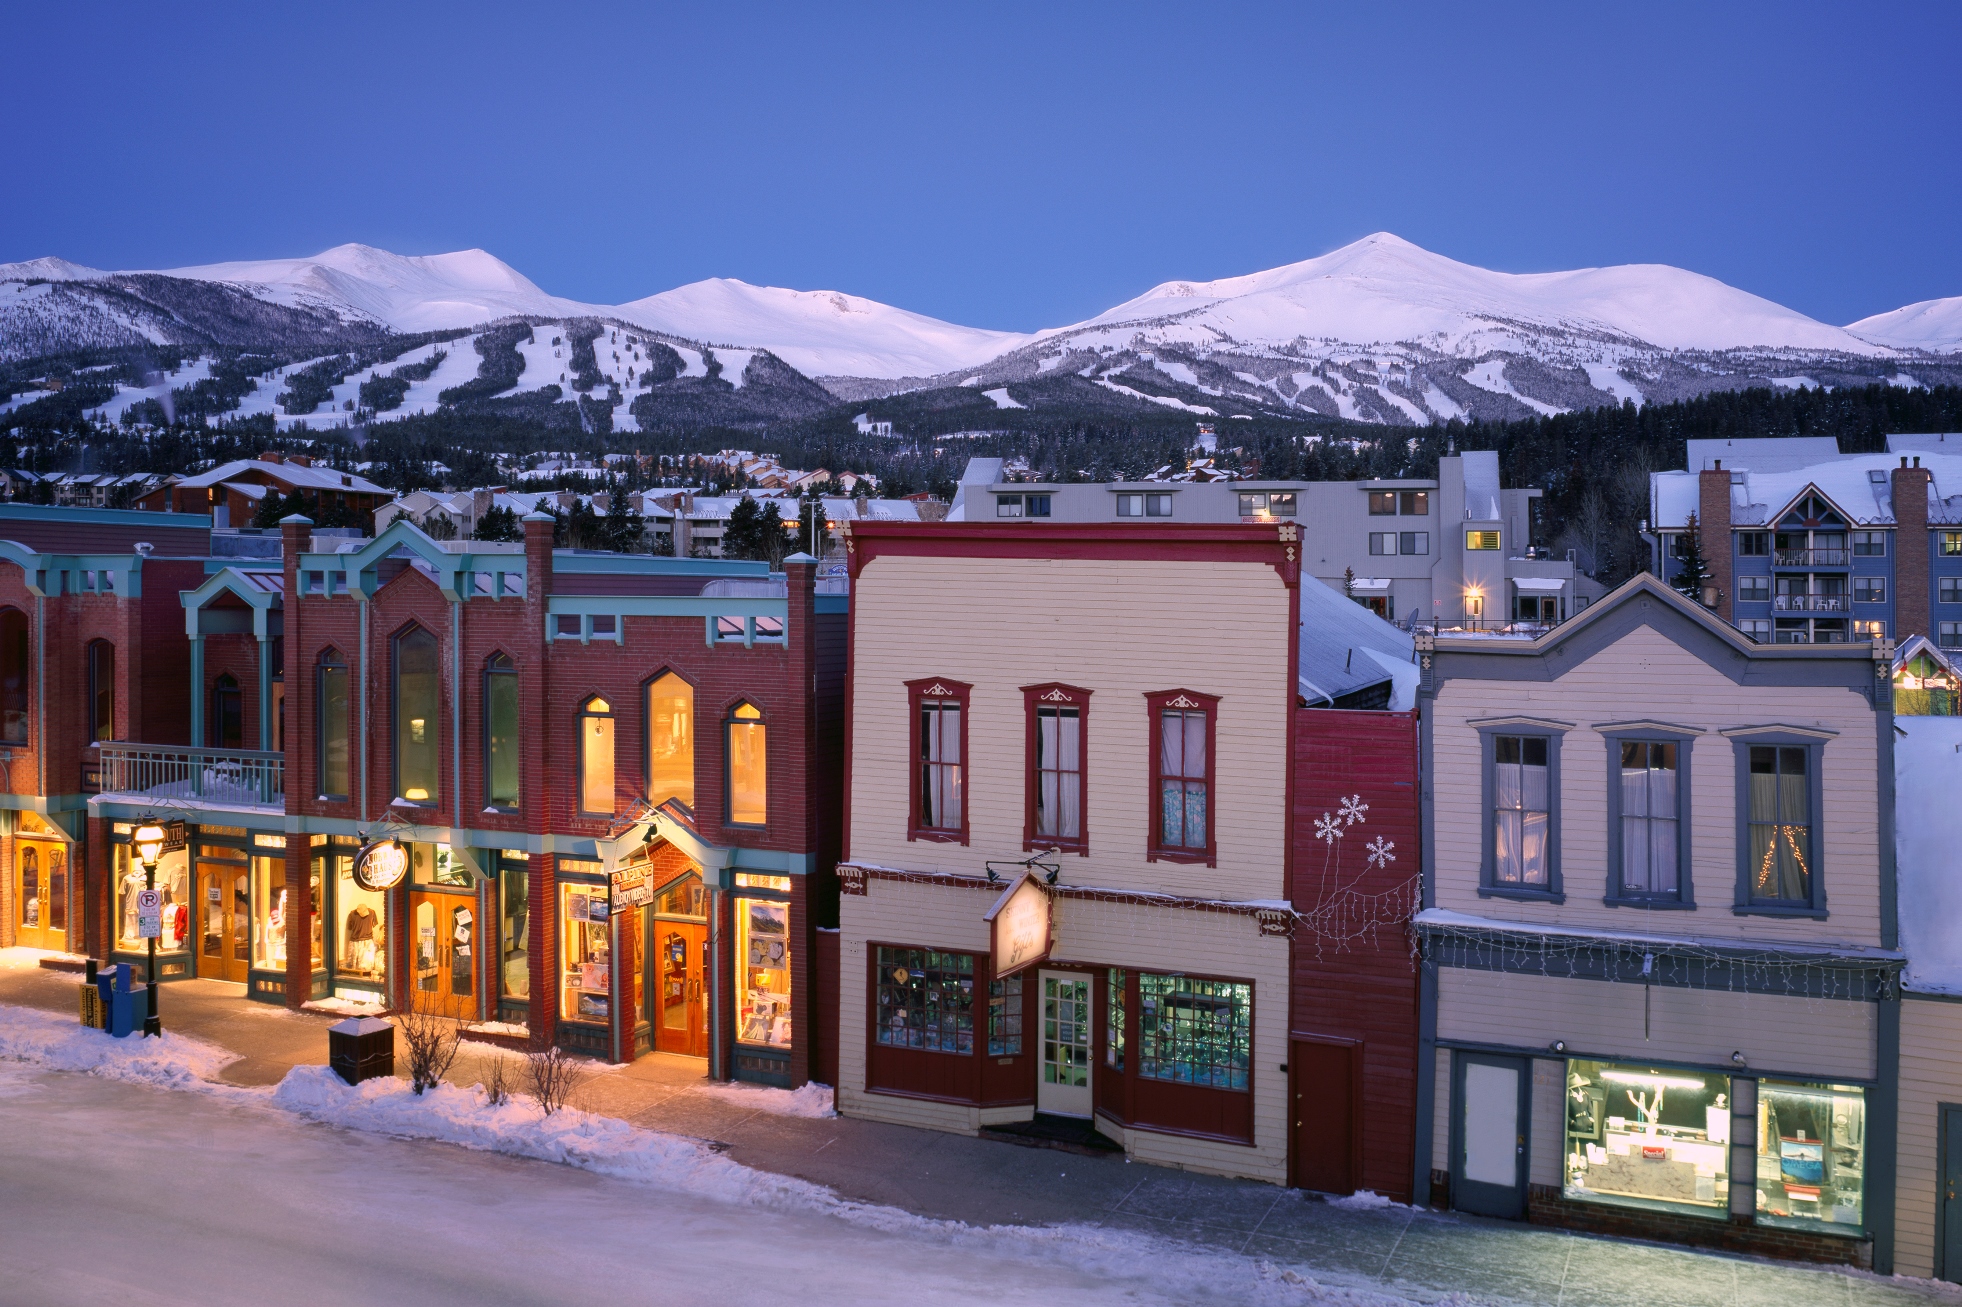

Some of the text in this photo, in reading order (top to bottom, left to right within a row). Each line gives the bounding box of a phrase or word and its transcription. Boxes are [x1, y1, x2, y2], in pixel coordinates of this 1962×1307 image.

[611, 865, 652, 886] ALPINE
[1010, 930, 1034, 963] Gifts
[1781, 1158, 1822, 1170] OMEGA
